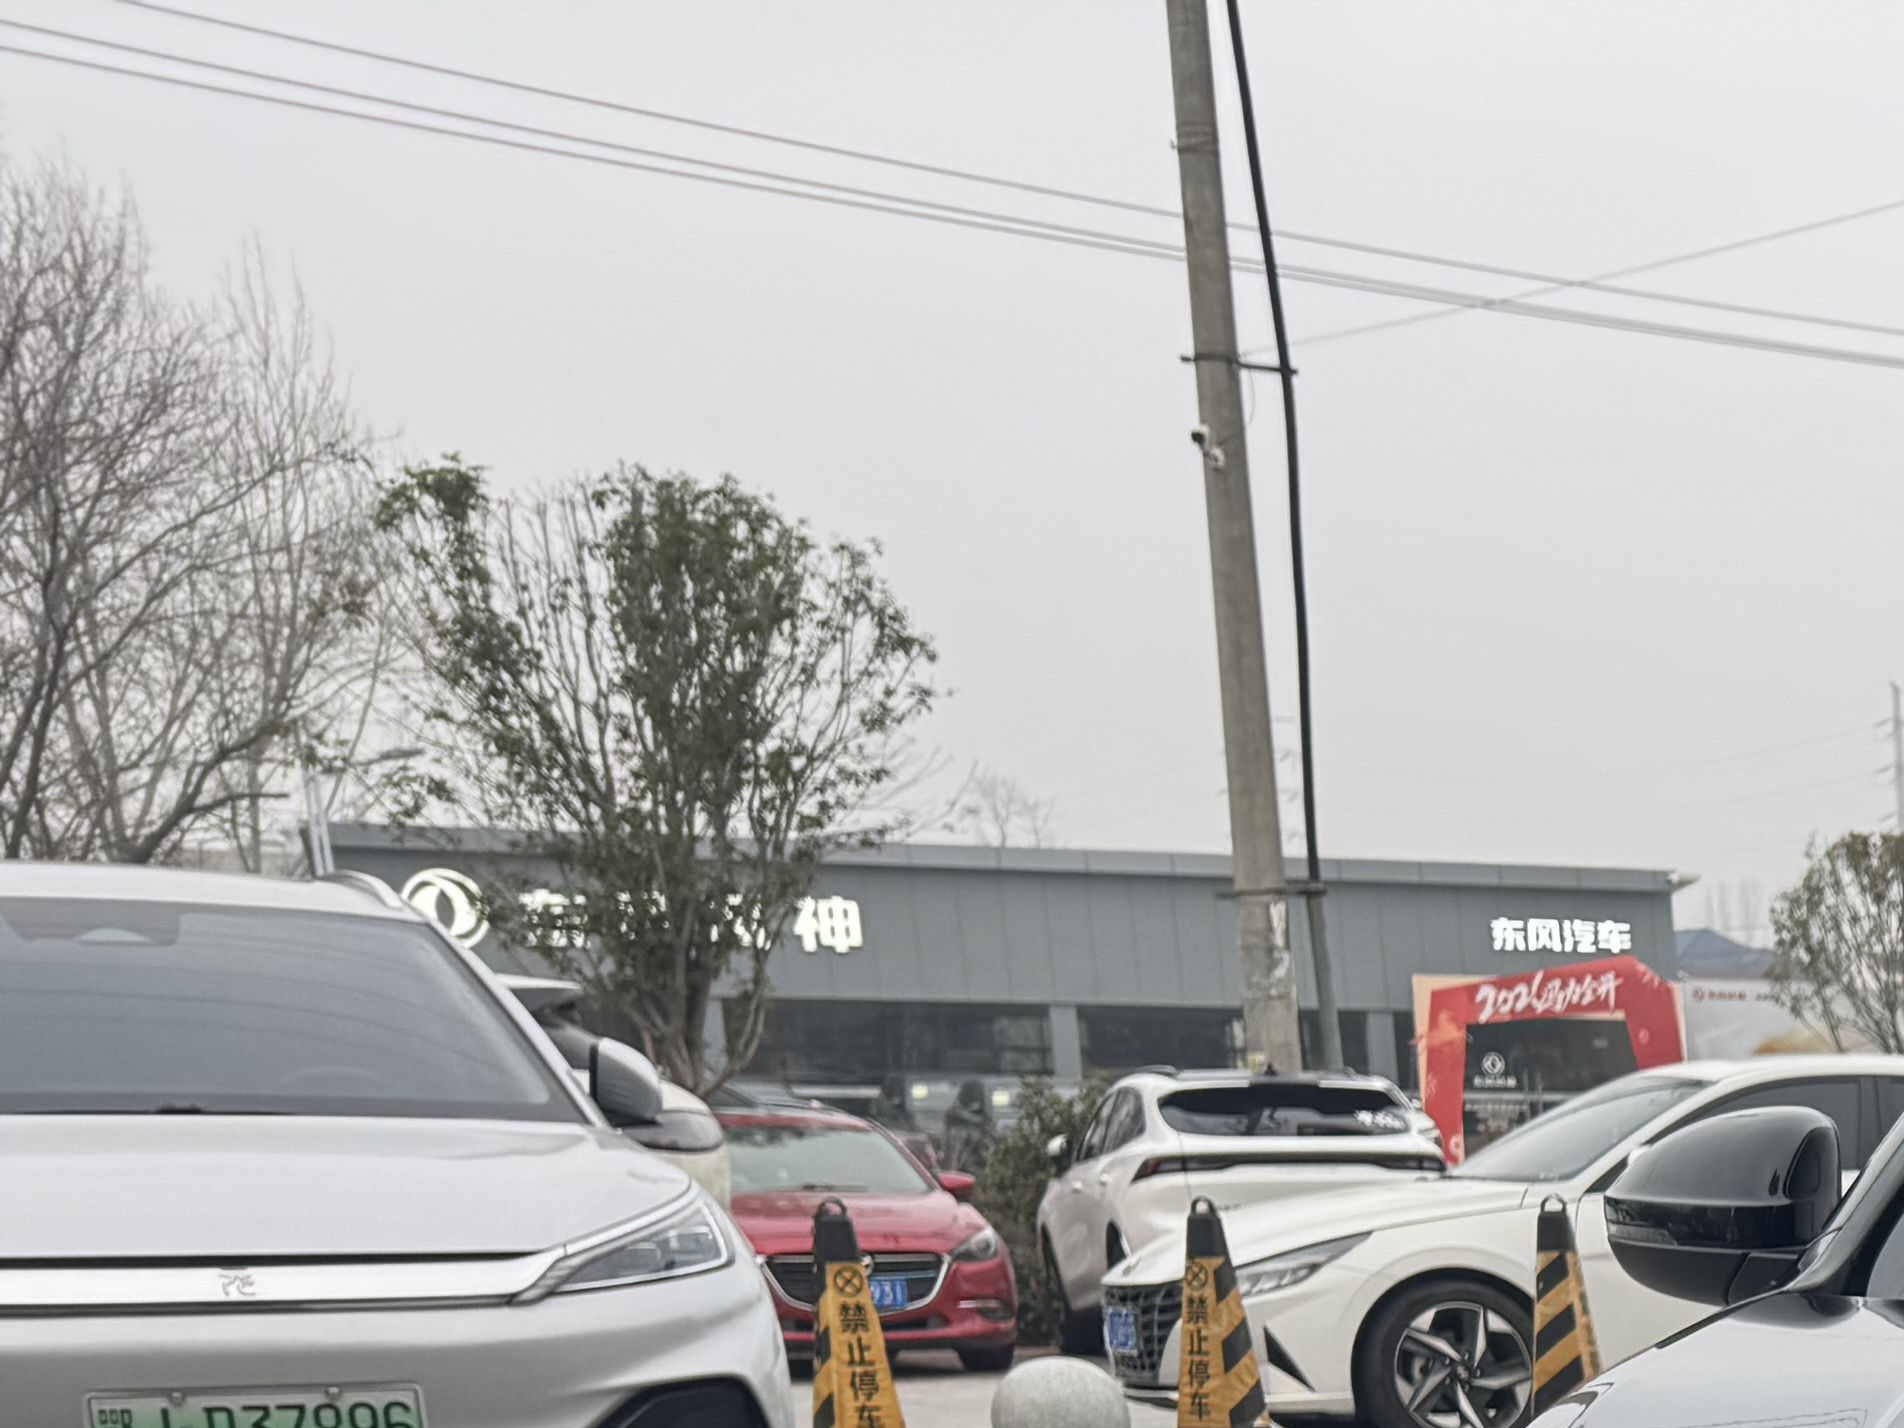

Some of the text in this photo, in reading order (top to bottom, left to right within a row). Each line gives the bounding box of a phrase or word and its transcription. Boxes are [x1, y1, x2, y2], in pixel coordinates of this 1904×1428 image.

[1490, 916, 1632, 954] 东风汽车
[1186, 1296, 1211, 1421] 禁止停车
